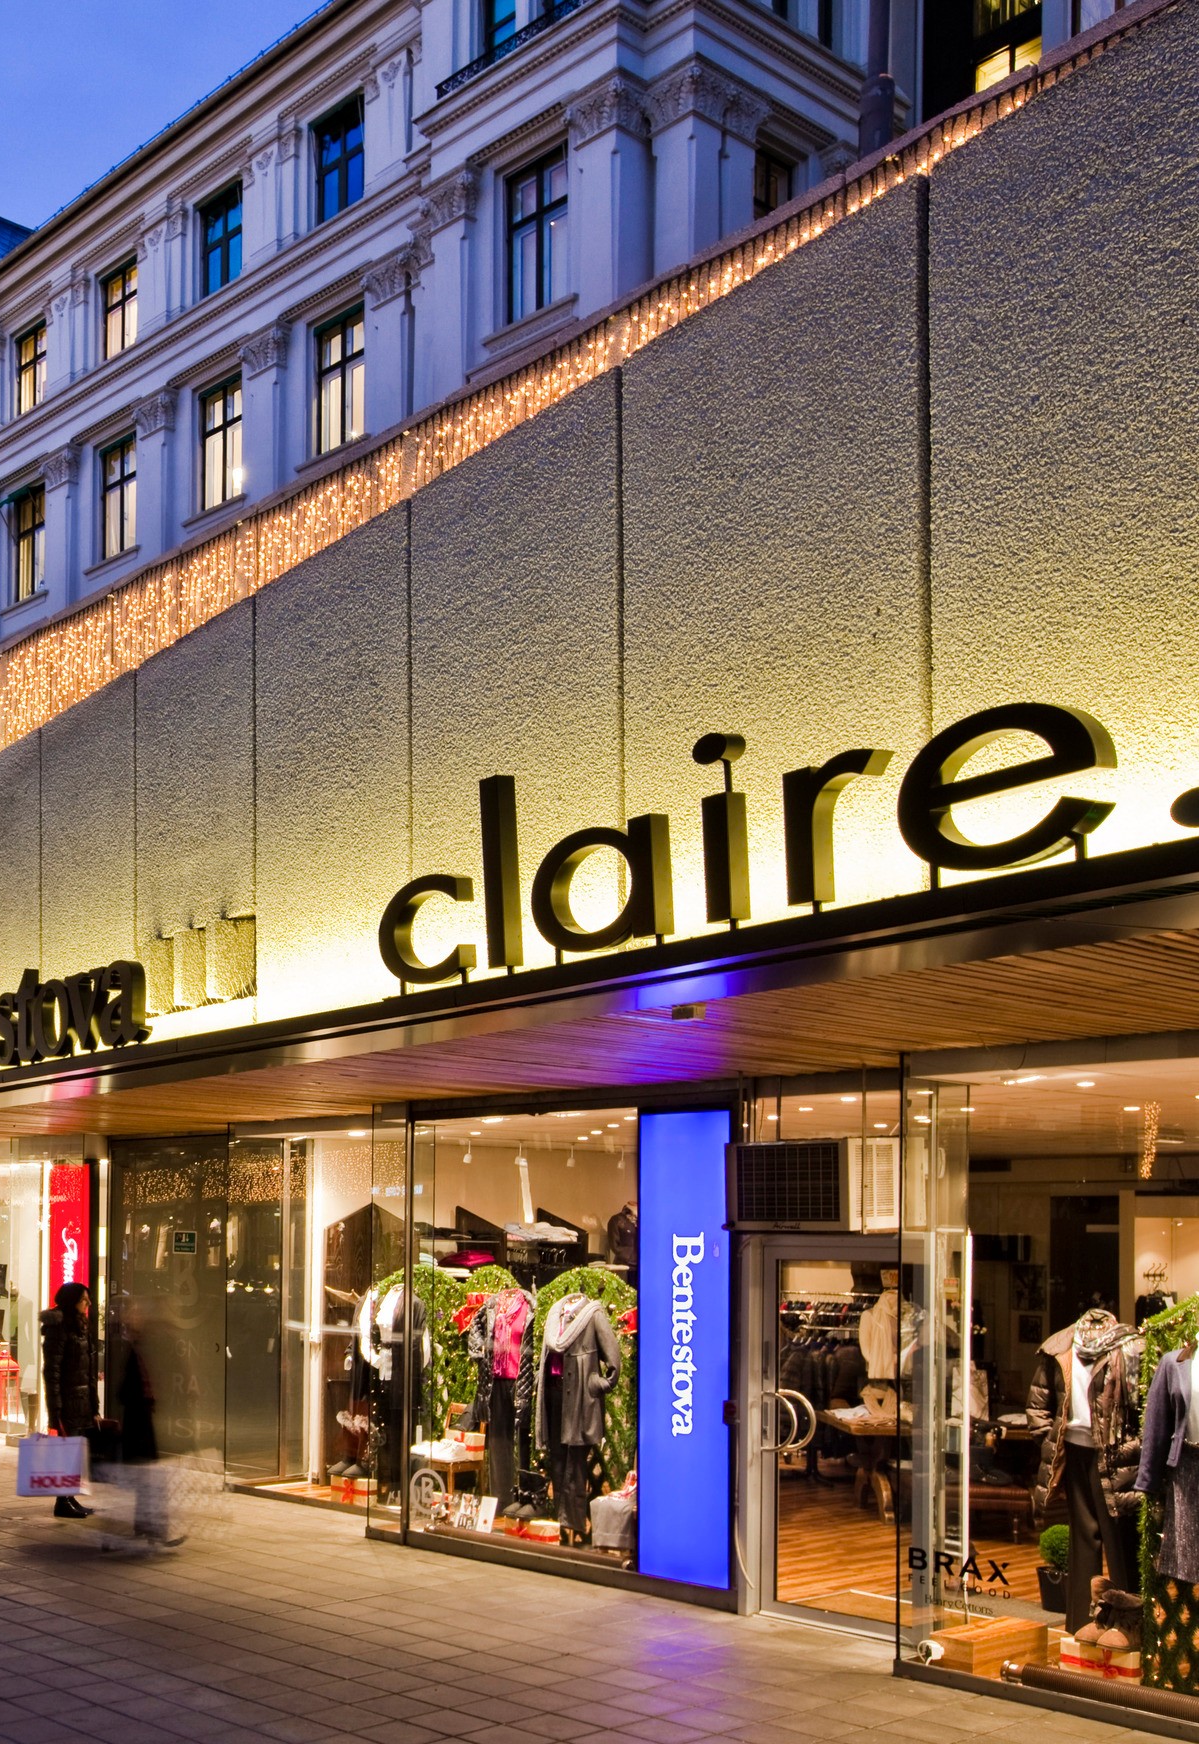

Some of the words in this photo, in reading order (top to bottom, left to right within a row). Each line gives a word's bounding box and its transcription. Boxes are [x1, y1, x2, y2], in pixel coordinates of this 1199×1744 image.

[672, 1231, 705, 1437] Bentestova
[908, 1547, 1010, 1586] BRAX
[908, 1573, 949, 1589] FEEL
[960, 1583, 1010, 1600] GOOD
